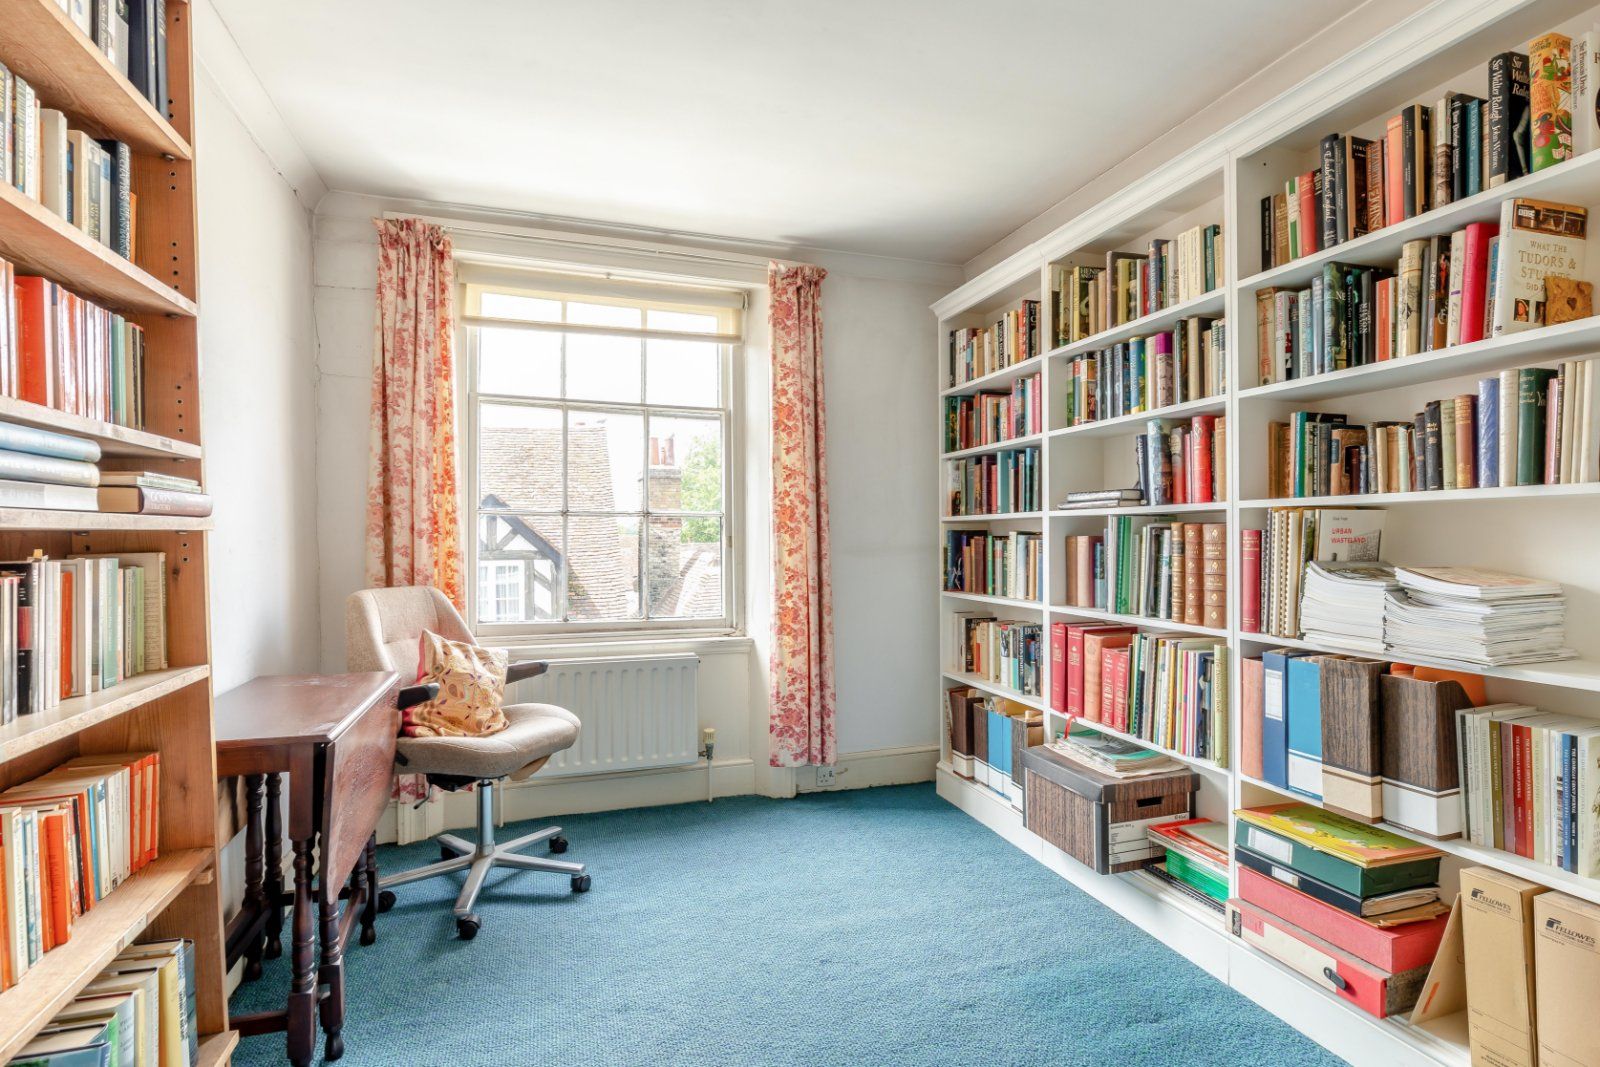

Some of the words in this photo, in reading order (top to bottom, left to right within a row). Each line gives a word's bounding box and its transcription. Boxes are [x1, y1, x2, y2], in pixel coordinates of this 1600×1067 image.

[1492, 58, 1503, 71] Sir
[1511, 54, 1522, 67] Sir
[1492, 70, 1503, 95] Walter
[1530, 241, 1549, 252] WHAT
[1553, 244, 1568, 253] THE
[1518, 250, 1564, 270] TUDORS
[1567, 258, 1577, 270] &
[1331, 536, 1368, 544] WASTELAND
[1479, 895, 1512, 911] FELLOWES
[1555, 925, 1596, 944] FELLOWES
